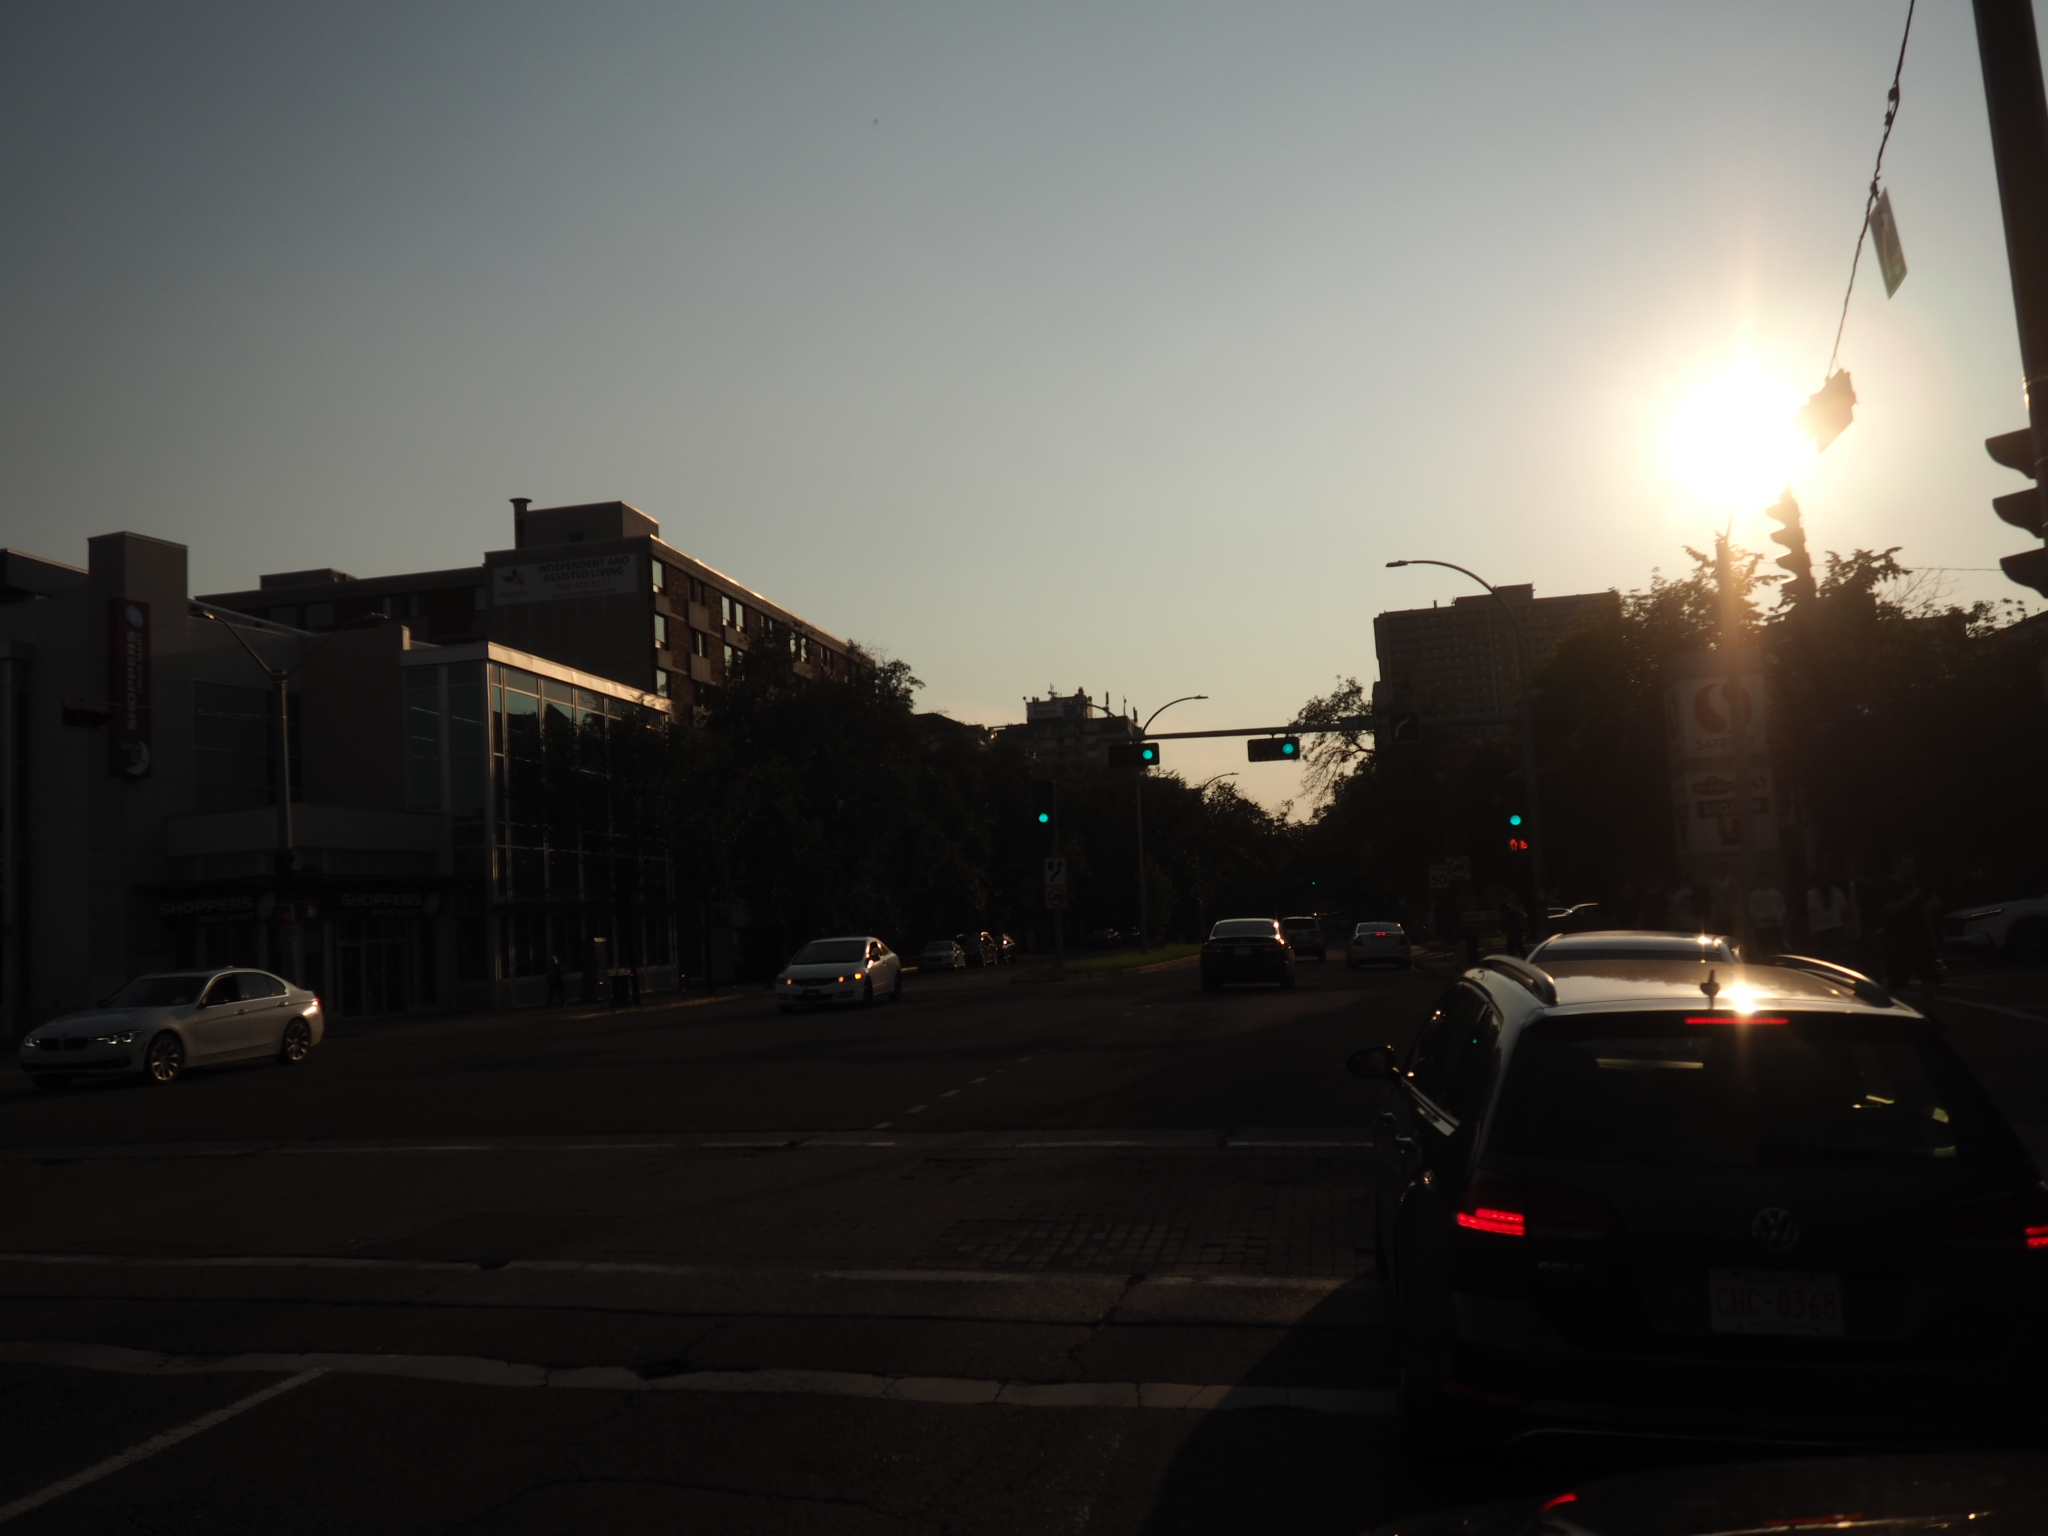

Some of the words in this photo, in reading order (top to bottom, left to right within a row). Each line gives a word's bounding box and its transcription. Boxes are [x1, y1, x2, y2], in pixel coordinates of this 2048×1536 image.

[537, 557, 605, 573] INDEPENDENT
[607, 555, 629, 566] AND
[543, 569, 589, 582] ASSISTED
[590, 566, 624, 578] LIVING
[126, 630, 137, 731] SHOPPERS
[1696, 736, 1756, 751] SAFEY
[1432, 875, 1447, 886] 50
[159, 896, 254, 916] SHOPPERS
[340, 893, 422, 907] SHOPPERS
[1715, 1286, 1837, 1319] CHC-0368
